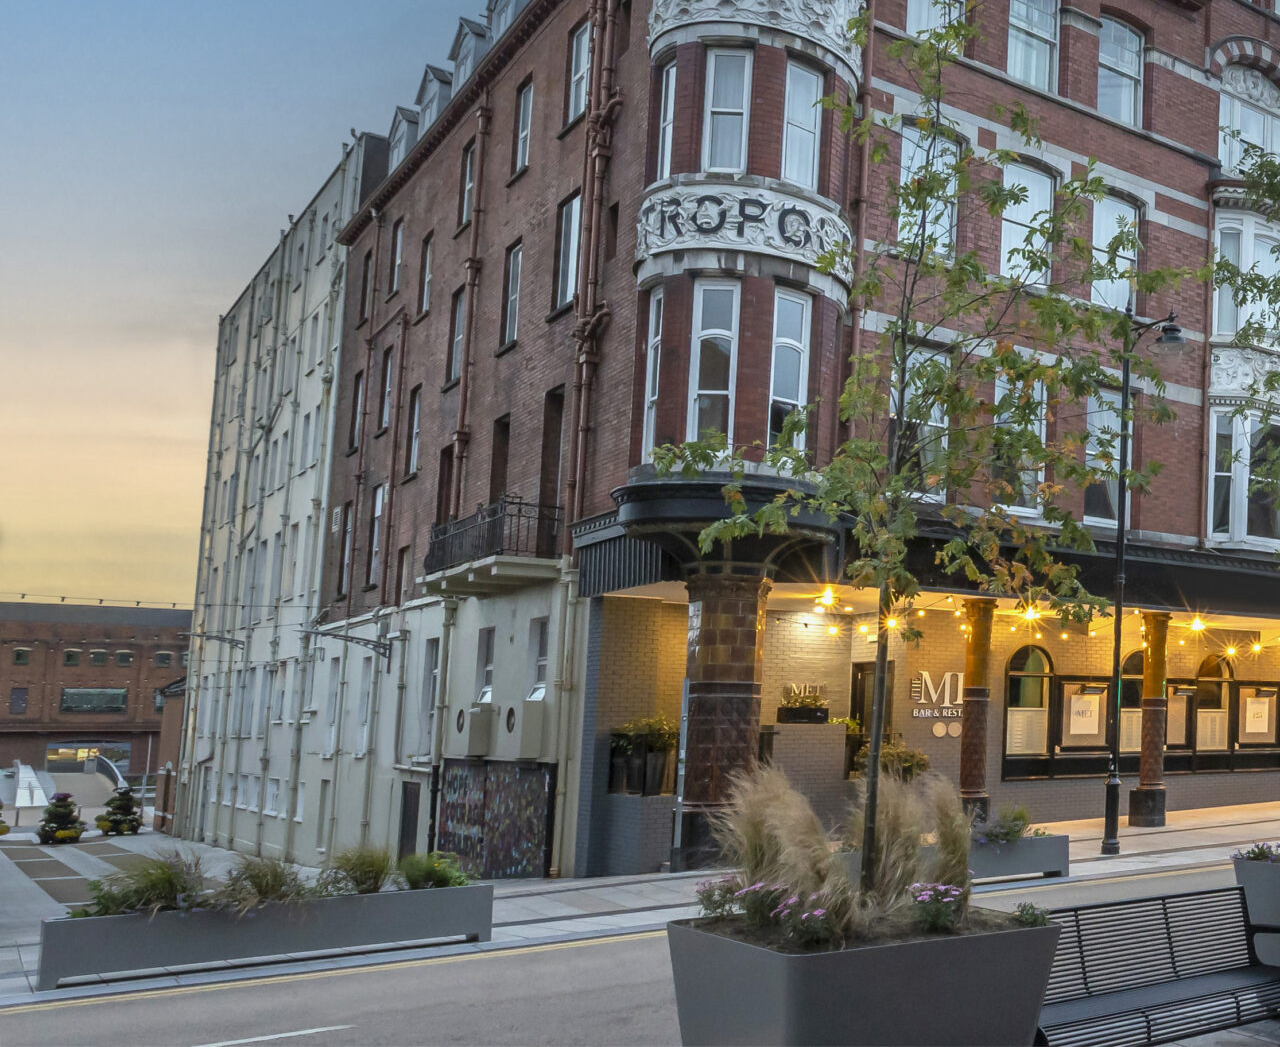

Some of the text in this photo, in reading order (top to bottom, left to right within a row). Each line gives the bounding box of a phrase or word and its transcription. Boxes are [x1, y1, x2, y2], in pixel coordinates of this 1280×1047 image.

[913, 708, 964, 717] BAR & REST
